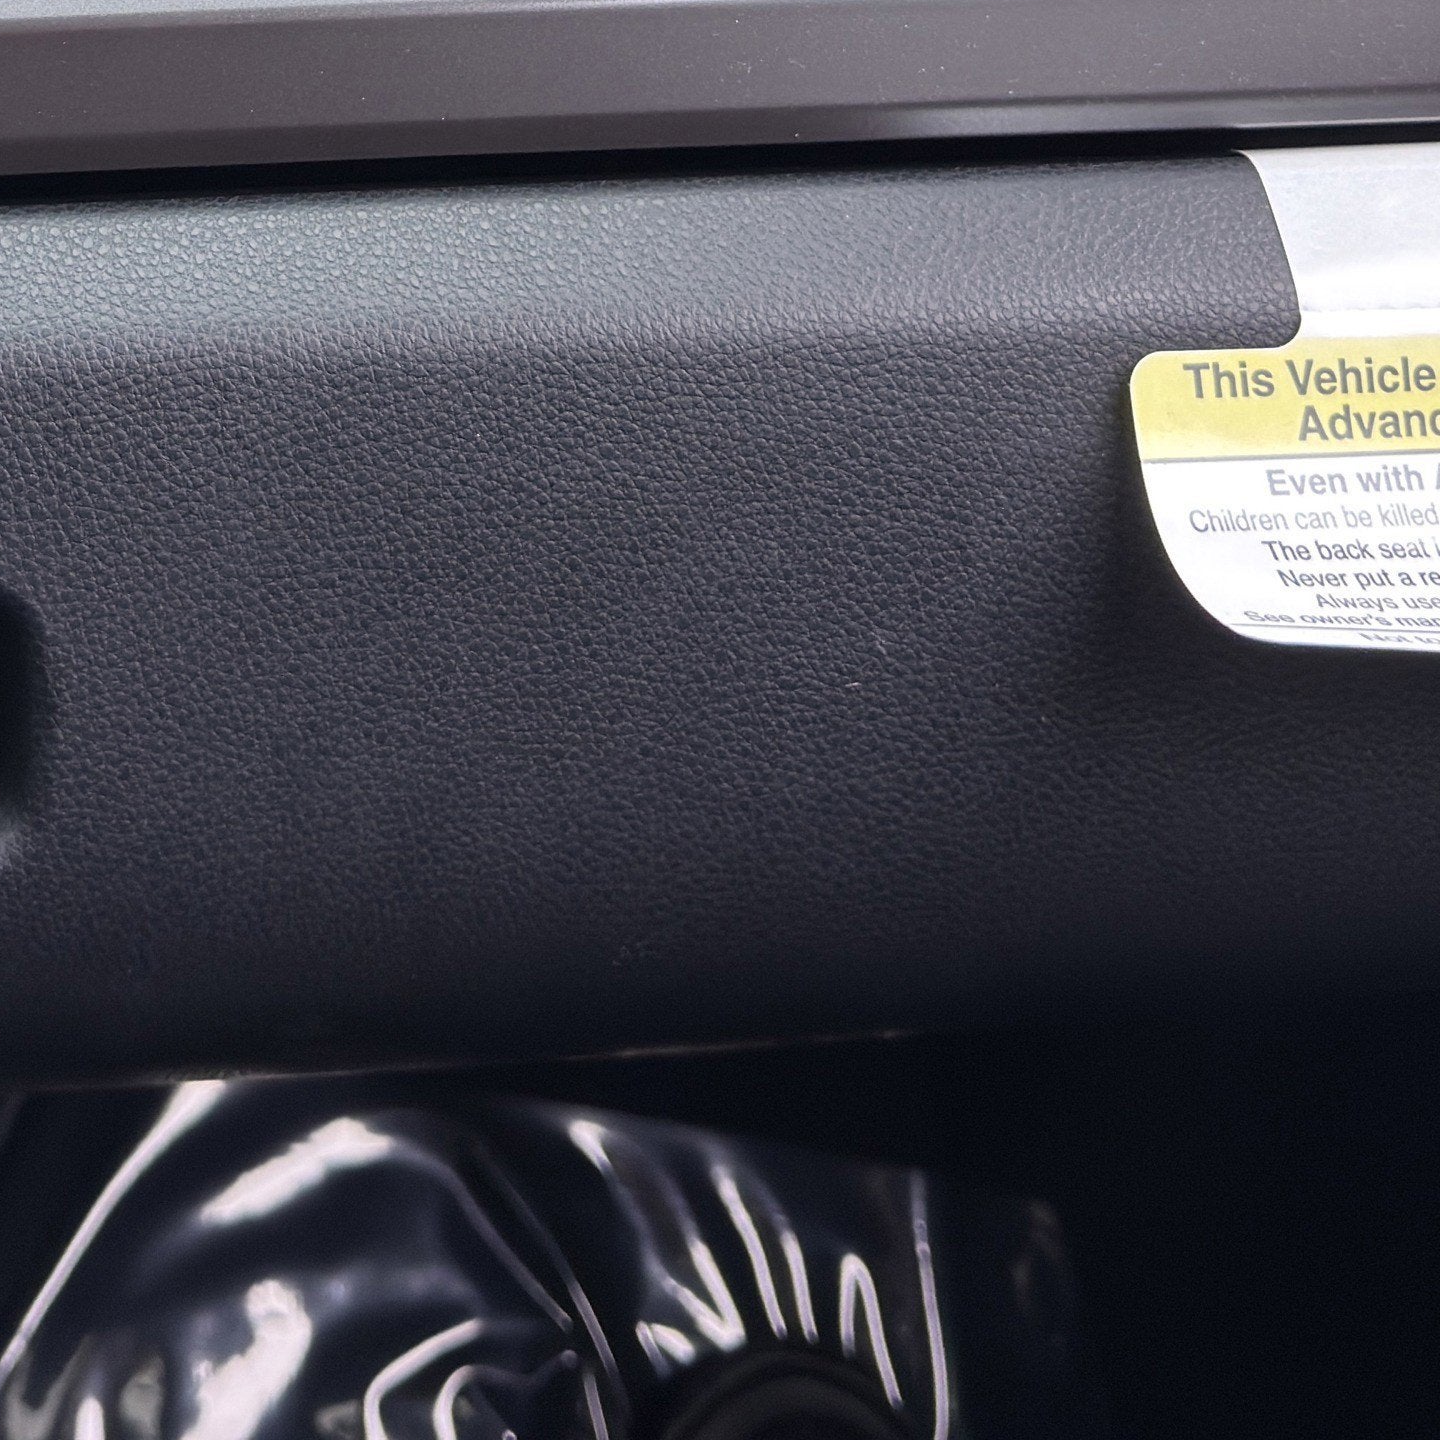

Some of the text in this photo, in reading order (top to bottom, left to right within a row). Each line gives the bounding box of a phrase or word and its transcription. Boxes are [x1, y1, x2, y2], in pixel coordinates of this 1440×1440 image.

[1182, 361, 1275, 399] This
[1285, 356, 1436, 396] Vehicle
[1266, 468, 1348, 496] Even
[1356, 464, 1424, 492] with
[1189, 508, 1289, 533] Children
[1294, 510, 1338, 530] can
[1341, 505, 1372, 528] be
[1377, 501, 1439, 527] killed
[1261, 540, 1311, 561] The
[1315, 538, 1374, 560] back
[1378, 538, 1431, 559] seat
[1277, 569, 1349, 588] Never
[1354, 569, 1394, 591] put
[1400, 572, 1416, 587] a
[1316, 593, 1397, 611] Always
[1243, 610, 1296, 623] See
[1301, 614, 1392, 626] owner's
[1359, 632, 1413, 643] Not
